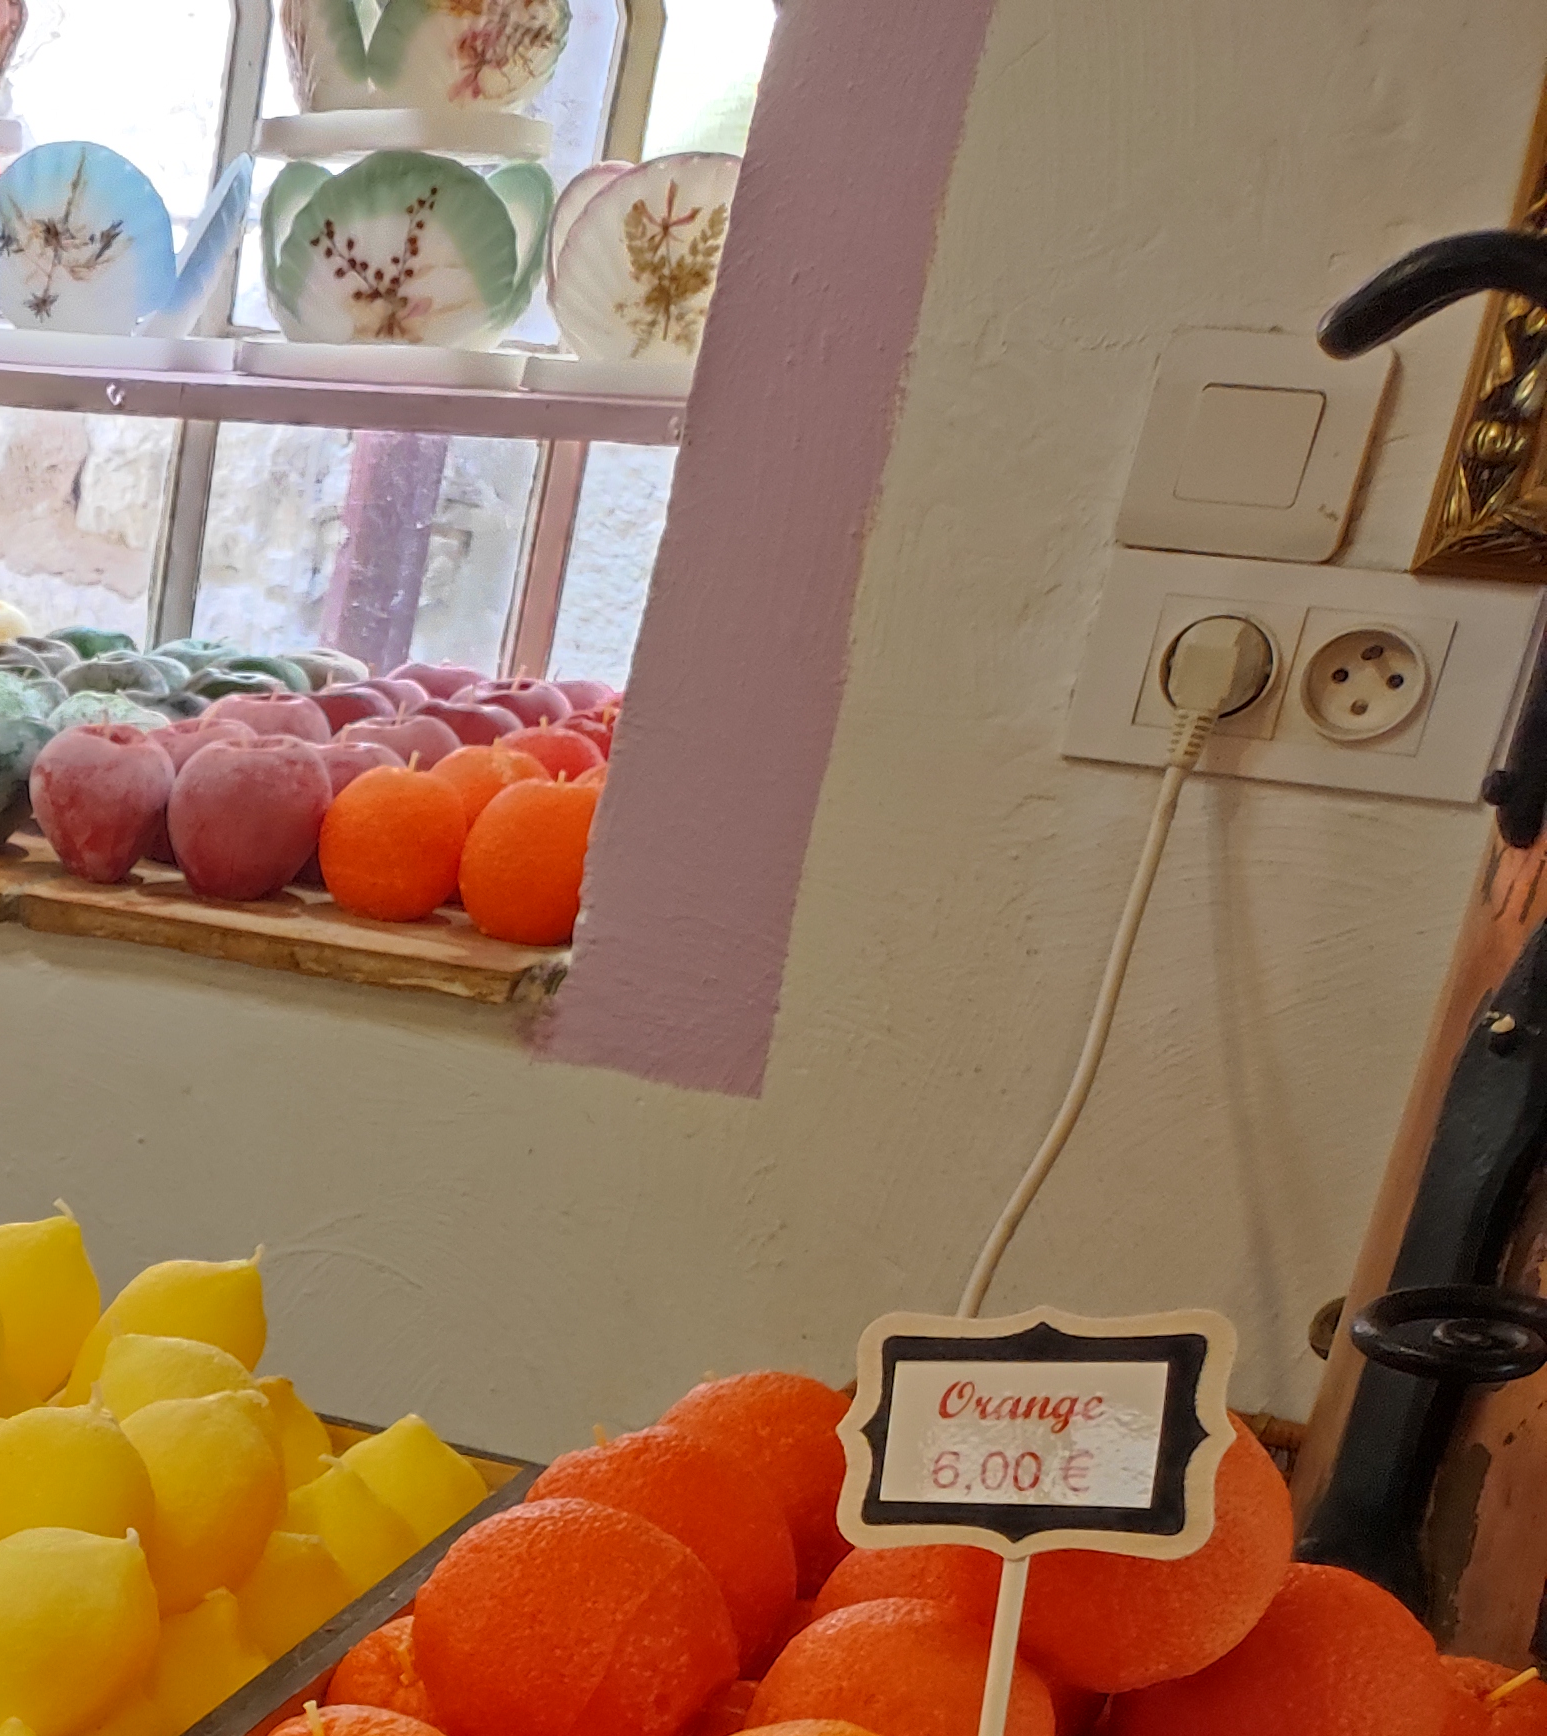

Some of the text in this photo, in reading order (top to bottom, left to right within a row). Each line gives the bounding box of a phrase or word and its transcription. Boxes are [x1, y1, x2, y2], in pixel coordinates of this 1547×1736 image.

[938, 1381, 1105, 1435] Orange
[932, 1450, 1095, 1494] 6,00 €
